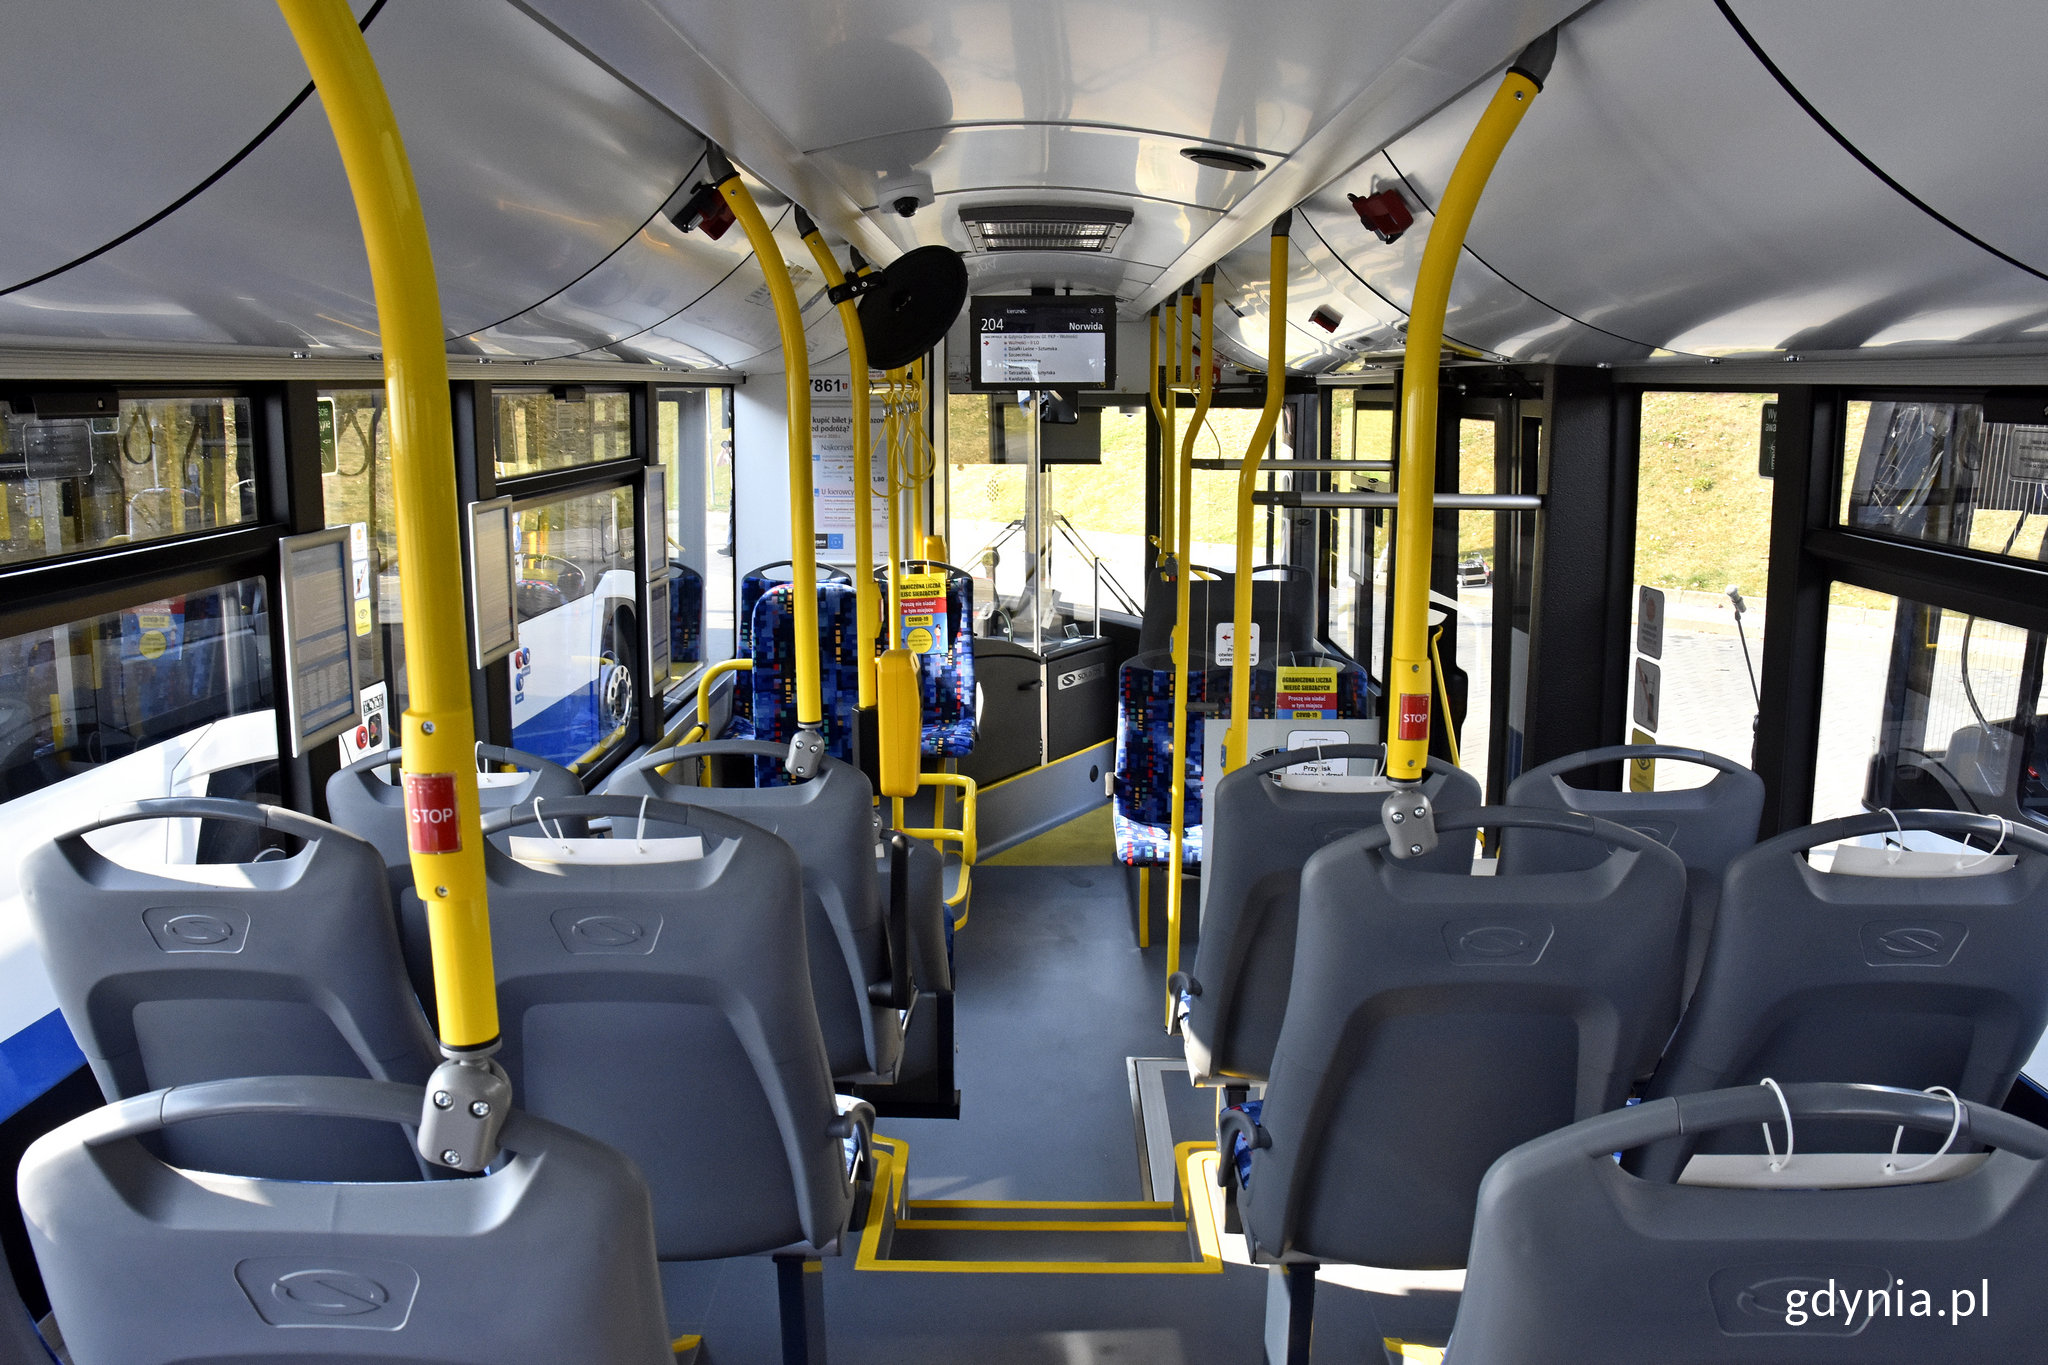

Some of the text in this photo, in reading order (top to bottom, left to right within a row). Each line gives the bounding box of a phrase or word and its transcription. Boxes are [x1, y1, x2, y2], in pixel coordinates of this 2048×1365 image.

[981, 318, 1004, 331] 204
[1069, 322, 1104, 331] Norwida
[812, 416, 830, 425] kupić
[831, 416, 847, 424] bilet
[820, 425, 850, 433] podróżą?
[828, 487, 855, 496] kierowcy
[1403, 713, 1427, 723] STOP
[1303, 765, 1331, 773] Przyisk
[411, 807, 454, 824] STOP
